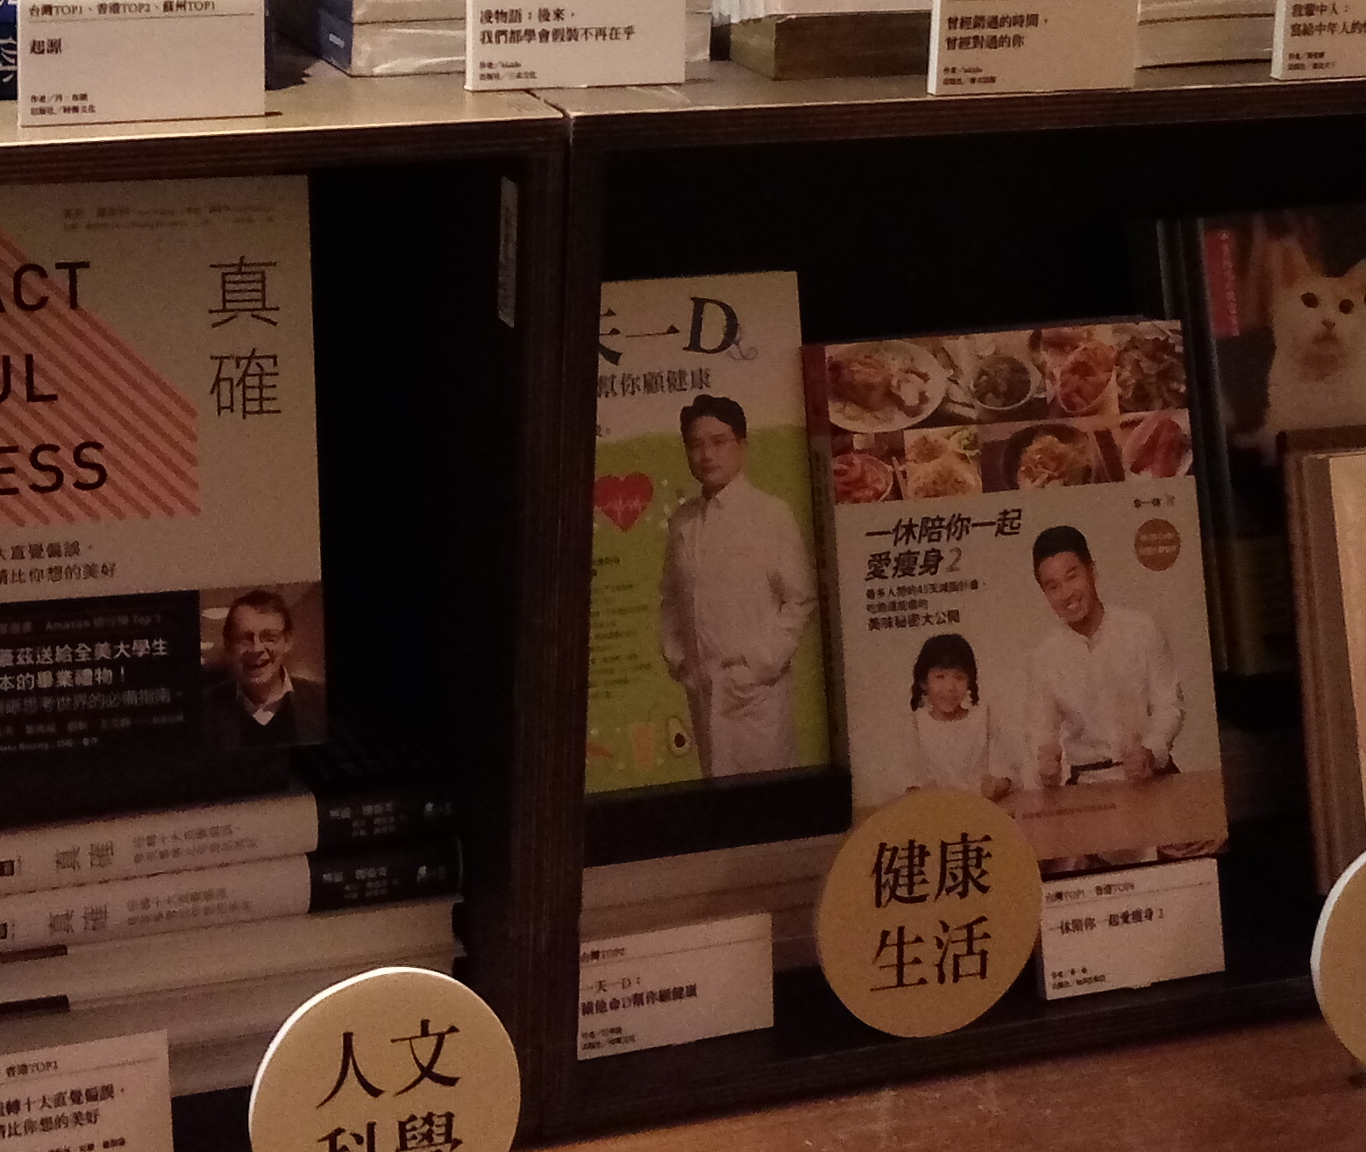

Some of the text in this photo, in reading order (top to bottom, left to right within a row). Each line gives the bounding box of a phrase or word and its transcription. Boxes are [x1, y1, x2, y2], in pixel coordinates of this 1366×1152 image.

[29, 38, 62, 54] 起源
[479, 25, 636, 45] 我們都學會假裝不再在乎
[208, 255, 282, 420] 真確
[866, 508, 1022, 546] 一休陪你一起
[865, 547, 963, 581] 愛瘦身2
[871, 833, 994, 908] 健康
[869, 916, 992, 994] 生活
[316, 1019, 461, 1109] 人文
